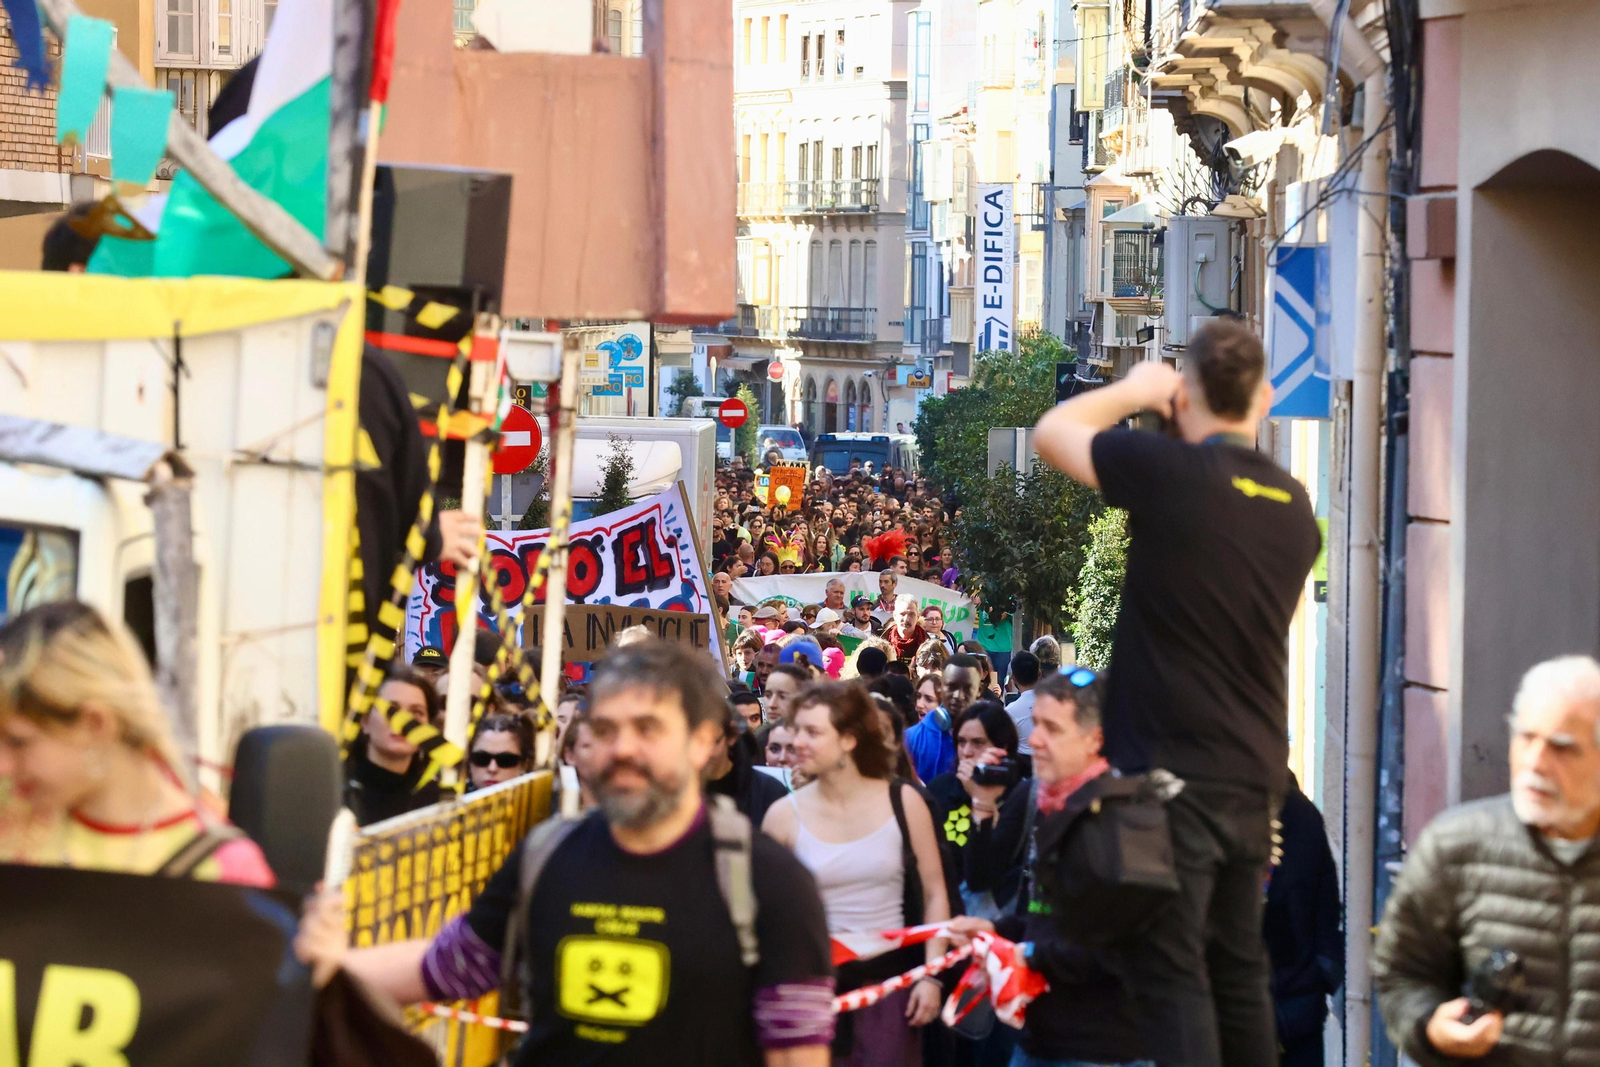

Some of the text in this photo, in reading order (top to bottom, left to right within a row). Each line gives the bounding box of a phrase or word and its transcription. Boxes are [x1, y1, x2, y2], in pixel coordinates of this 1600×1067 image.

[983, 190, 1004, 309] E-DIFICA
[625, 374, 642, 385] RO
[612, 517, 675, 597] EL
